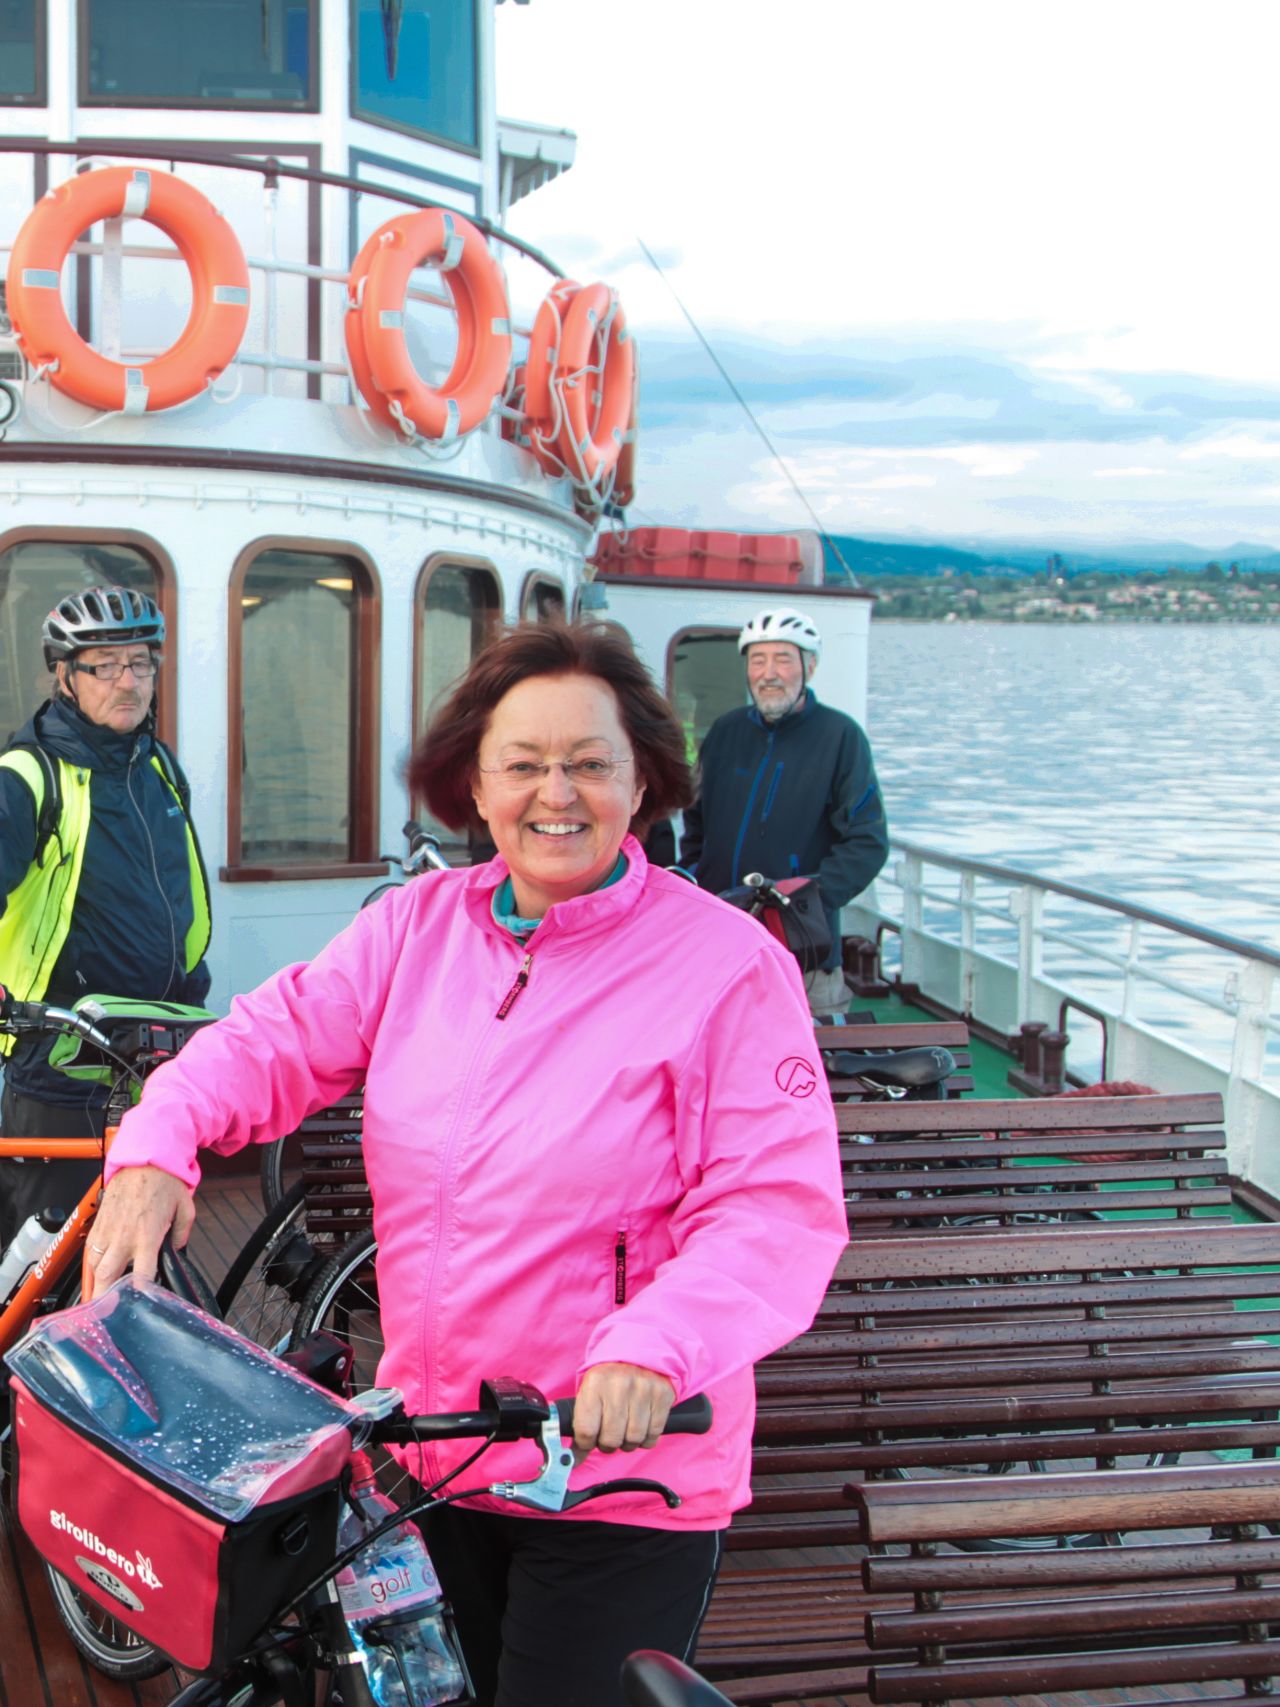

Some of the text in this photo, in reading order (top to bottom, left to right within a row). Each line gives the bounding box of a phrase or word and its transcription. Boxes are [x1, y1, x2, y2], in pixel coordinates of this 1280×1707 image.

[617, 1257, 625, 1301] STORMBERG
[50, 1509, 135, 1577] girolibero
[370, 1567, 411, 1604] golf
